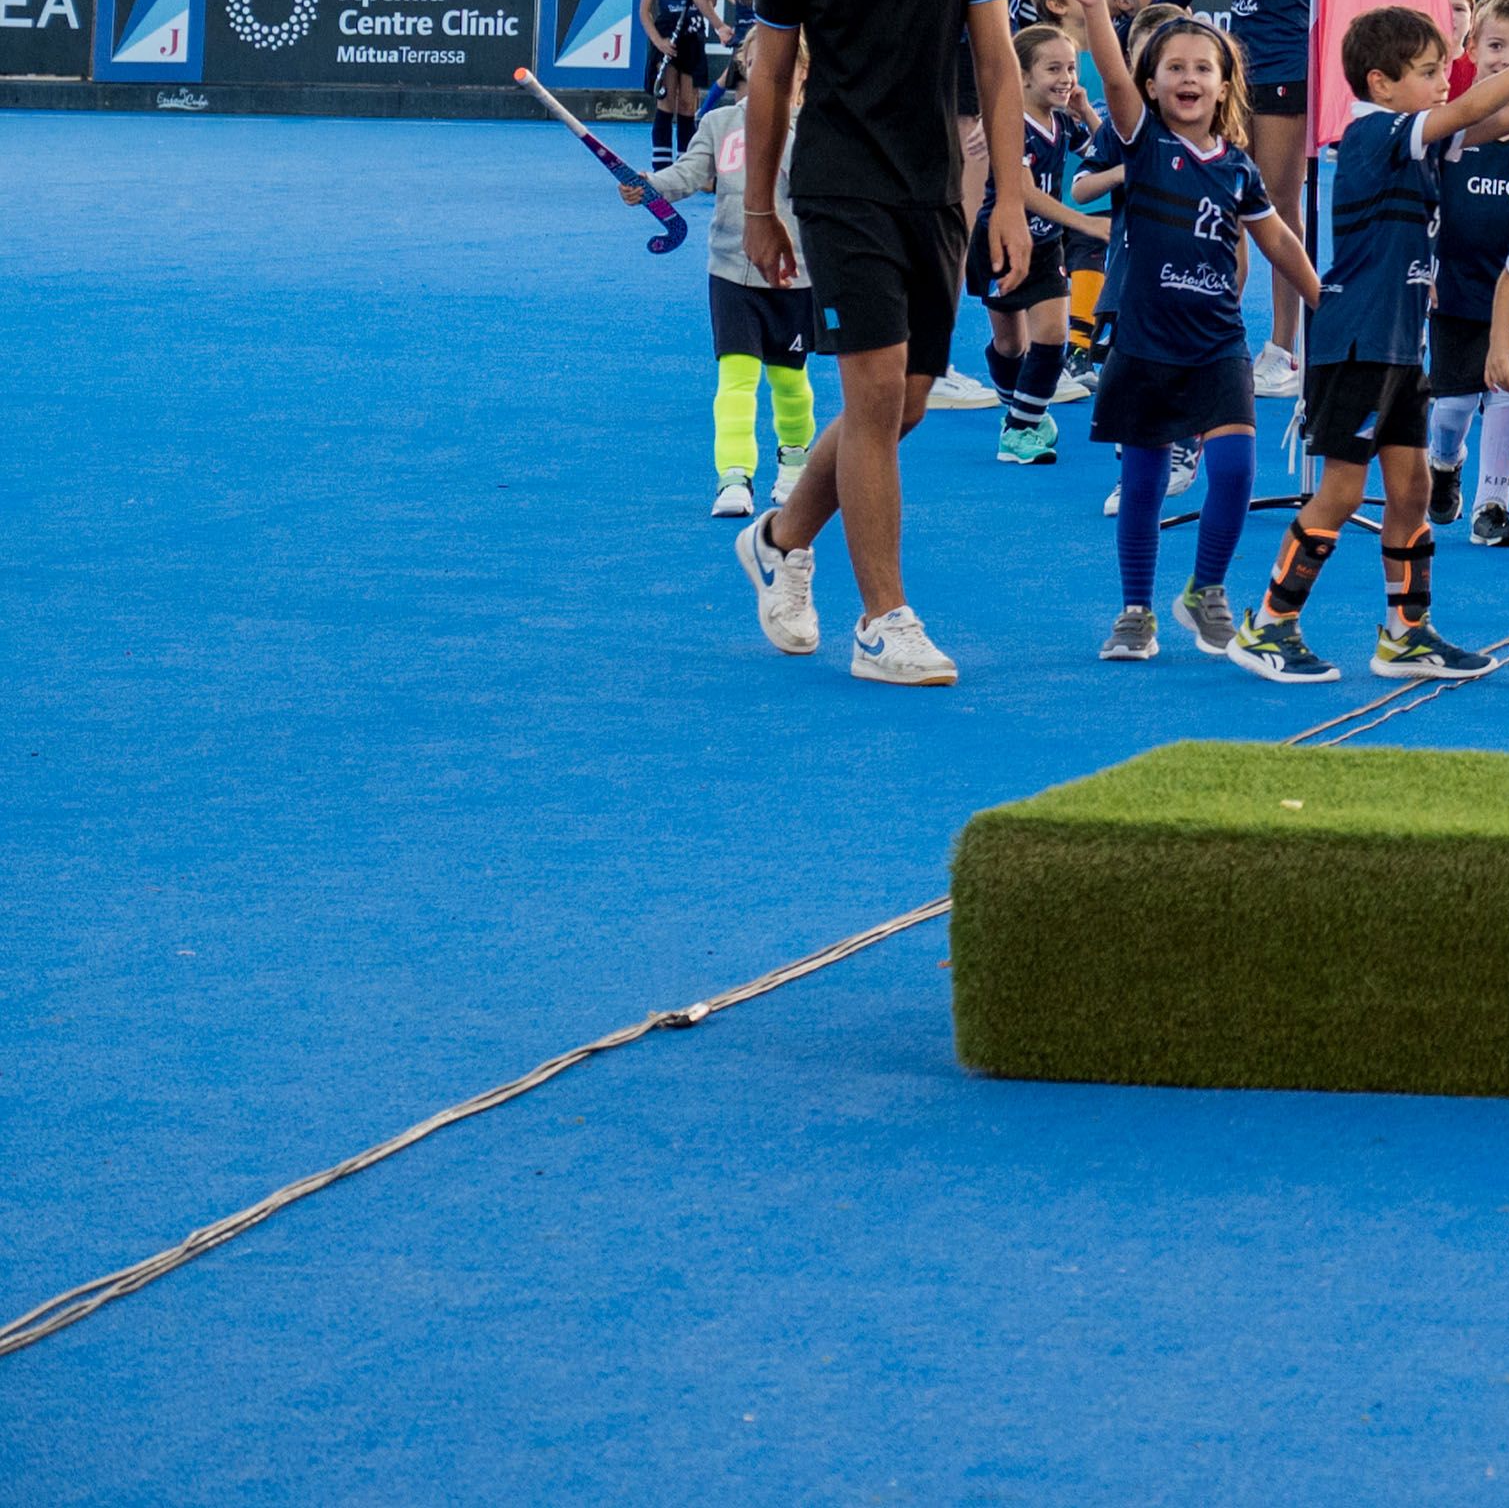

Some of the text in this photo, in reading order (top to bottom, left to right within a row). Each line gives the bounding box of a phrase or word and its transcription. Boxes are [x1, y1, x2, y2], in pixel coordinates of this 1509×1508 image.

[338, 8, 519, 37] Centre Clínic
[159, 28, 180, 56] J
[336, 45, 466, 64] MútuaTerrassa
[602, 34, 623, 62] J
[1194, 196, 1224, 241] 22
